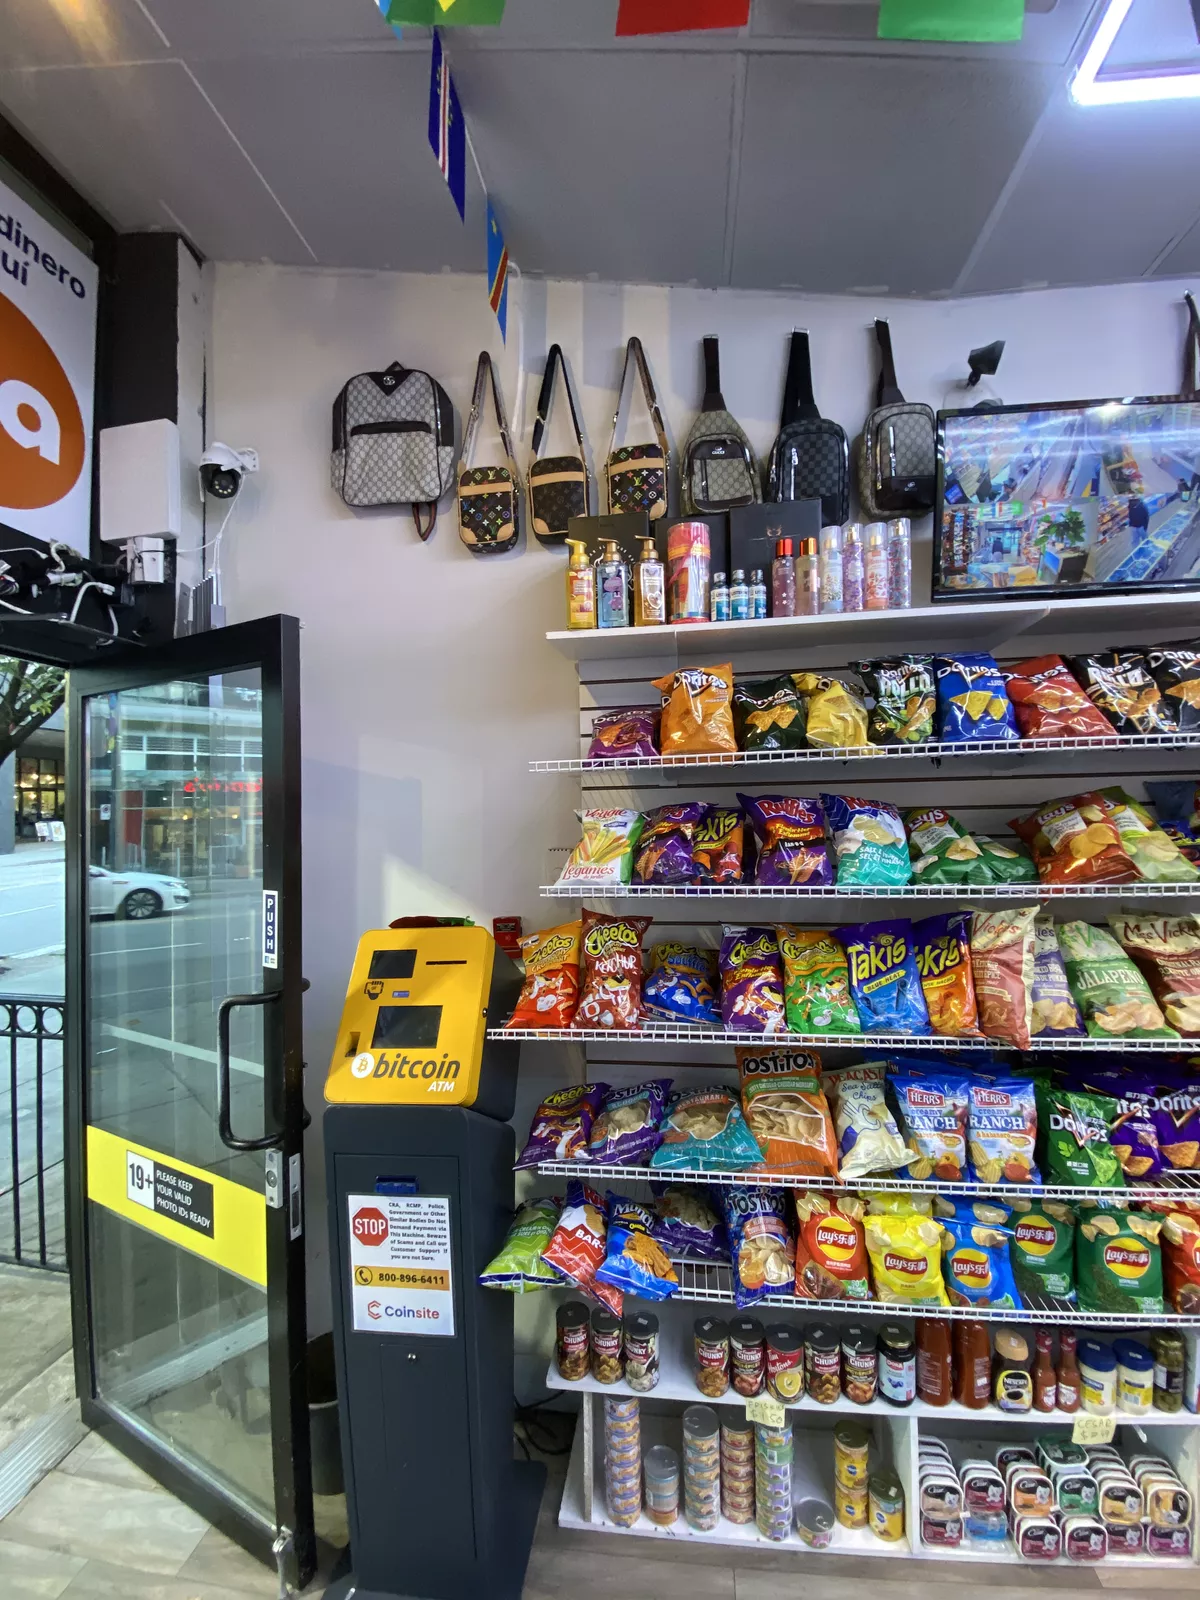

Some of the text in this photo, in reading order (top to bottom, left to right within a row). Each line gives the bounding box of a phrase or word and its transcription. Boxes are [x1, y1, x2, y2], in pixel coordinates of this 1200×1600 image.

[0, 214, 86, 299] dinero
[1147, 650, 1200, 668] Dorit
[755, 798, 817, 824] Ruffles
[266, 898, 274, 950] PUSH
[588, 922, 639, 956] Cheetos
[847, 937, 906, 986] Takis
[915, 938, 961, 976] akis
[372, 1053, 461, 1079] bitcoin
[427, 1080, 455, 1092] ATM
[852, 1091, 877, 1102] Chips
[911, 1091, 941, 1105] HERR'S
[976, 1091, 1007, 1105] HERR'S
[905, 1115, 958, 1130] RANCH
[969, 1115, 1026, 1130] RANCH
[128, 1161, 154, 1191] 19+
[156, 1169, 193, 1192] PLEASE KEEP
[156, 1183, 192, 1206] YOUR VALID
[156, 1197, 211, 1229] PHOTO IDs READY
[354, 1218, 387, 1236] STOP
[1016, 1227, 1036, 1241] Lay's
[818, 1229, 839, 1244] Lay's
[885, 1256, 908, 1270] Lay's
[1106, 1249, 1129, 1263] Lay's
[953, 1261, 975, 1275] Lay's
[378, 1272, 445, 1285] 800-896-6411
[384, 1305, 440, 1319] Coinsite
[563, 1334, 588, 1345] CHUNKY
[594, 1337, 619, 1348] CHUNKY
[625, 1344, 647, 1355] HUNKY
[698, 1348, 724, 1360] CHUNKY
[736, 1351, 762, 1361] CHUNKY
[767, 1350, 779, 1361] Tim
[849, 1358, 876, 1368] CHUNKY
